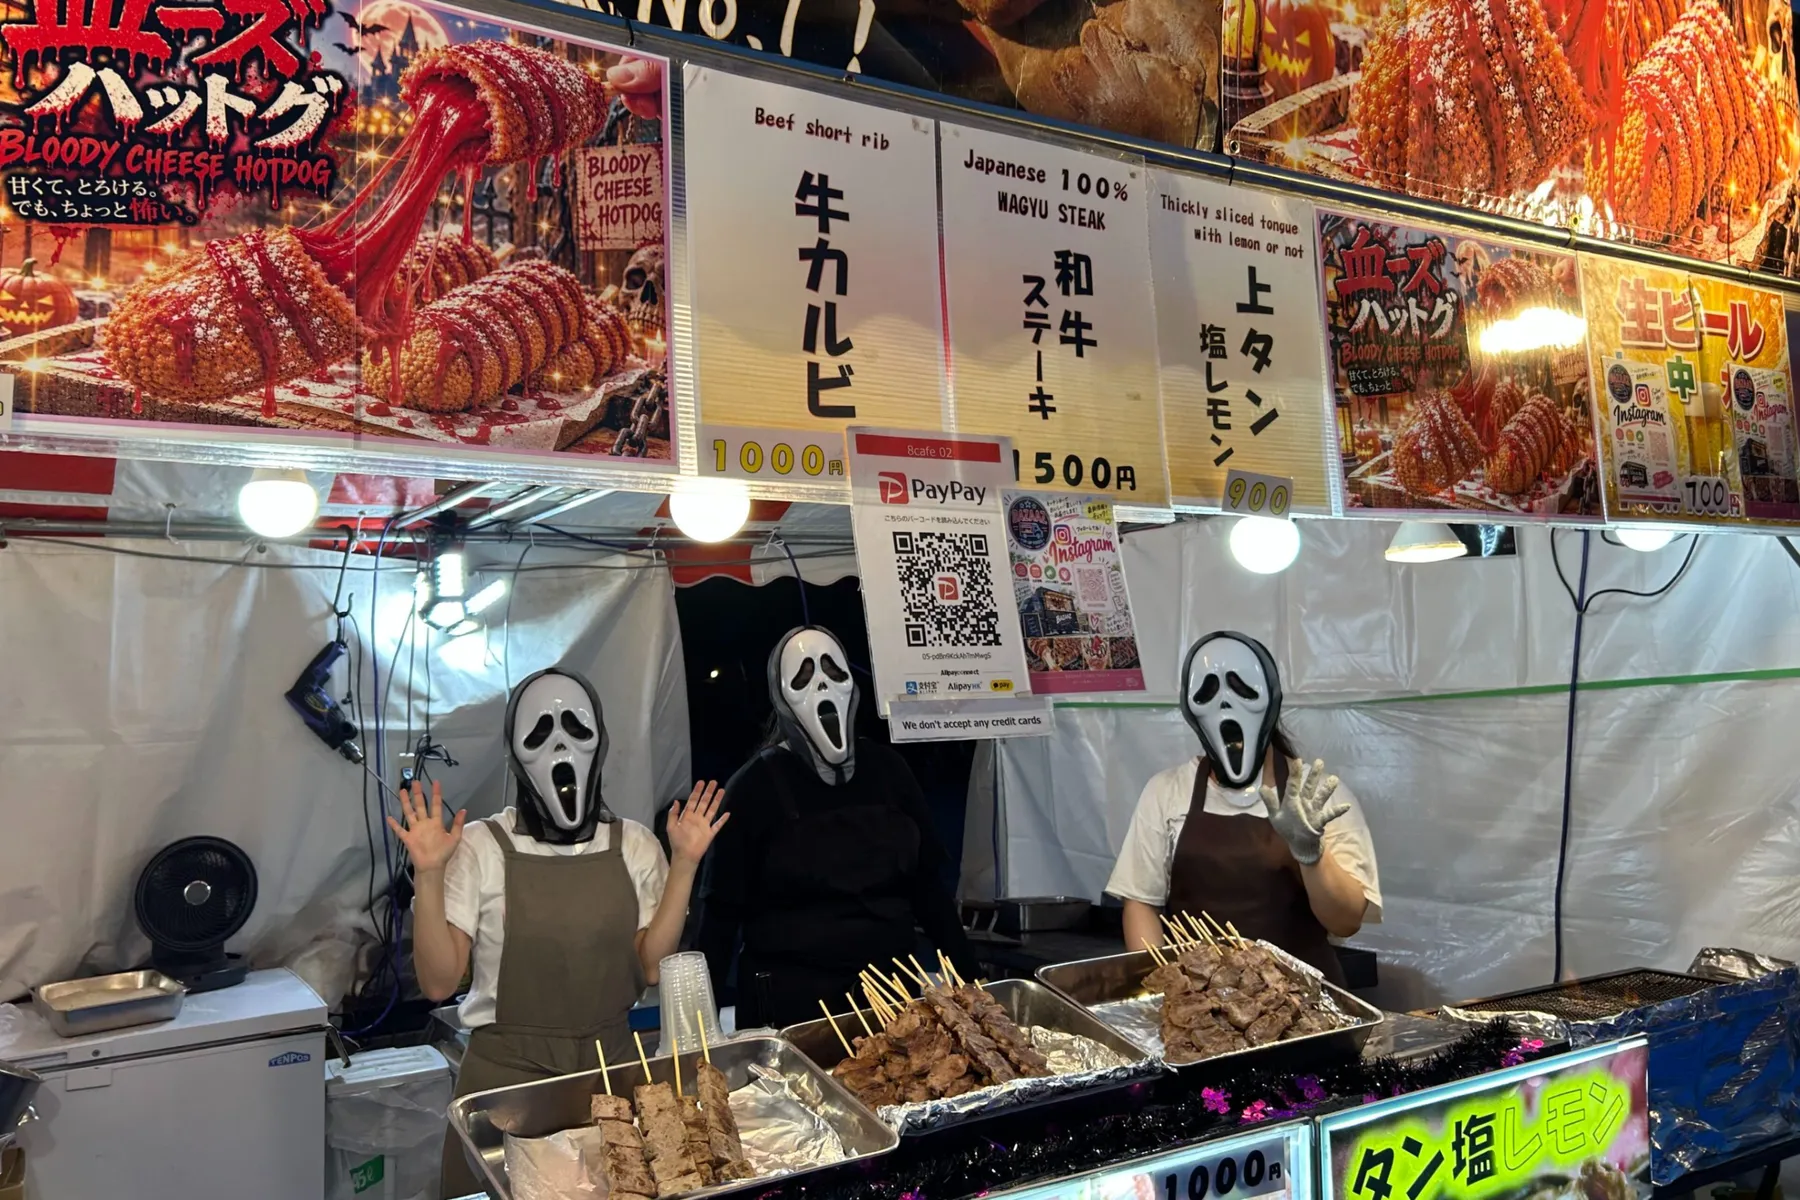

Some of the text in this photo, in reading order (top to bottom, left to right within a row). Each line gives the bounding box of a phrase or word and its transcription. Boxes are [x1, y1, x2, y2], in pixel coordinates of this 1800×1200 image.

[23, 60, 344, 150] ハットグ
[754, 106, 891, 152] Beef short rib
[0, 128, 332, 188] BLOODY CHEESE HOTDOG
[587, 153, 652, 178] BLOODY
[963, 148, 1129, 202] Japanese 100%
[7, 176, 158, 198] 甘くて、とろける。
[594, 177, 654, 202] CHEESE
[12, 198, 197, 224] でも、ちょっと怖い。
[598, 202, 662, 226] HOTDOG
[997, 190, 1106, 231] WAGYU STEAK
[1160, 193, 1299, 236] Thickly sliced tongue
[1194, 225, 1304, 259] with lemon or not
[1336, 226, 1446, 295] 血ーズ
[794, 169, 857, 418] 牛カルビ
[1054, 249, 1099, 358] 和牛
[1349, 291, 1459, 341] ハットグ
[1616, 276, 1765, 360] 生ビール
[1022, 274, 1057, 420] ステーキ
[1236, 265, 1280, 437] 上タン
[1199, 323, 1235, 467] 塩レモン
[1665, 353, 1697, 402] 中
[1613, 403, 1667, 428] Instagram
[713, 438, 845, 477] 1000円
[907, 444, 953, 459] 8cafe 02
[1012, 449, 1137, 492] 1500円
[911, 478, 987, 506] PayPay
[1228, 477, 1288, 515] 900
[1048, 537, 1116, 566] Instagram
[902, 715, 1042, 730] We don't accept any credit cards
[1352, 1081, 1625, 1200] タン塩レモン
[1164, 1149, 1282, 1200] 1000円
